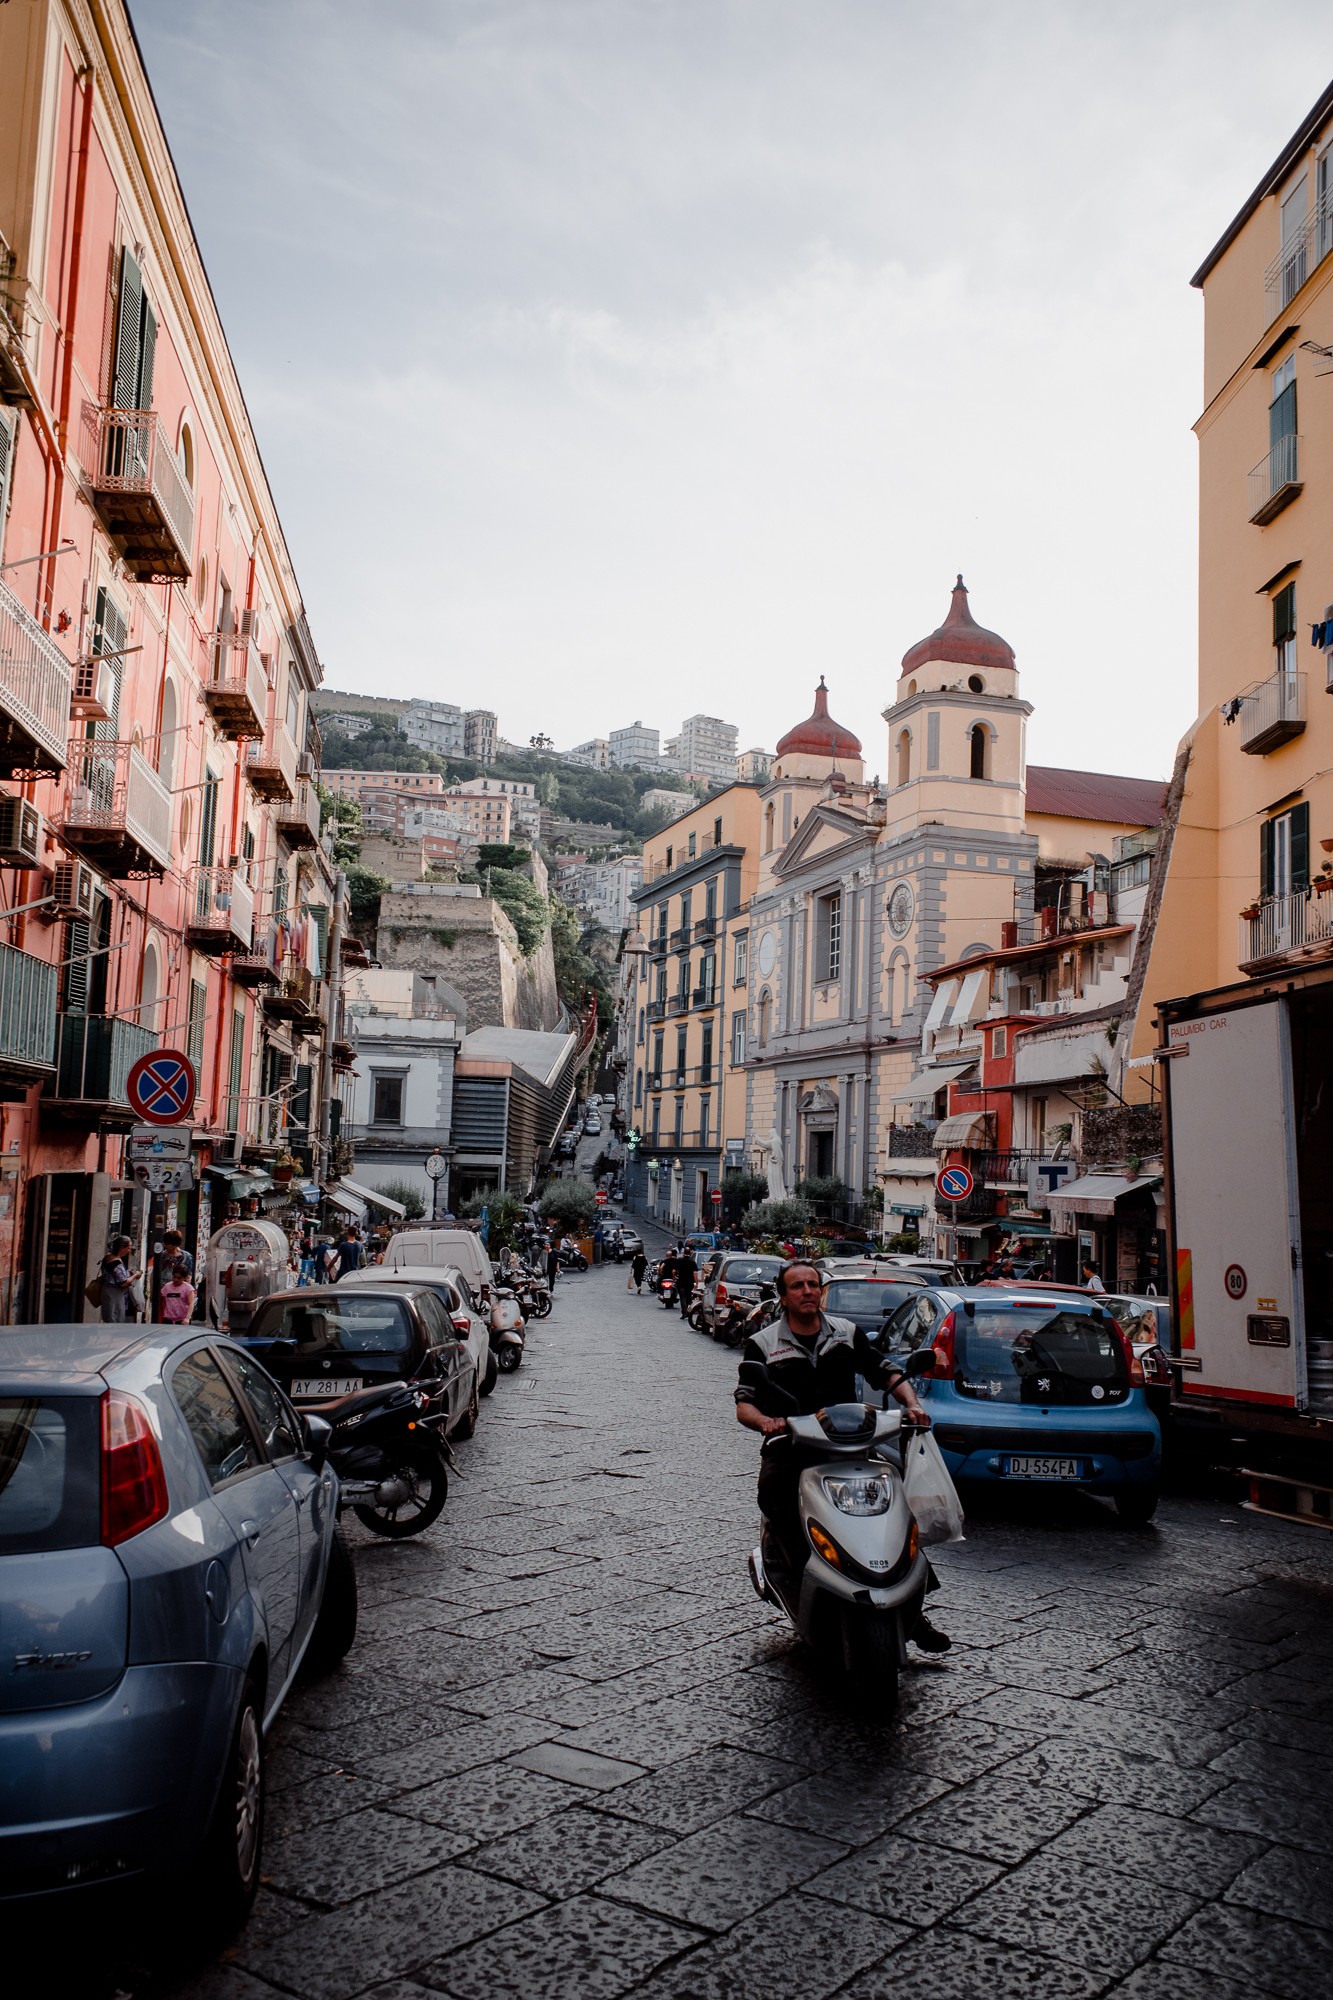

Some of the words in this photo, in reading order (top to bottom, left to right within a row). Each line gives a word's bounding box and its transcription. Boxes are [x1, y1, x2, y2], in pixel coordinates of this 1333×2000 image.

[1171, 1022, 1206, 1038] PALUMBO
[1210, 1017, 1227, 1030] CAR
[1039, 1166, 1068, 1192] T
[1230, 1275, 1242, 1289] 80
[296, 1382, 310, 1394] AY
[317, 1381, 338, 1393] 281
